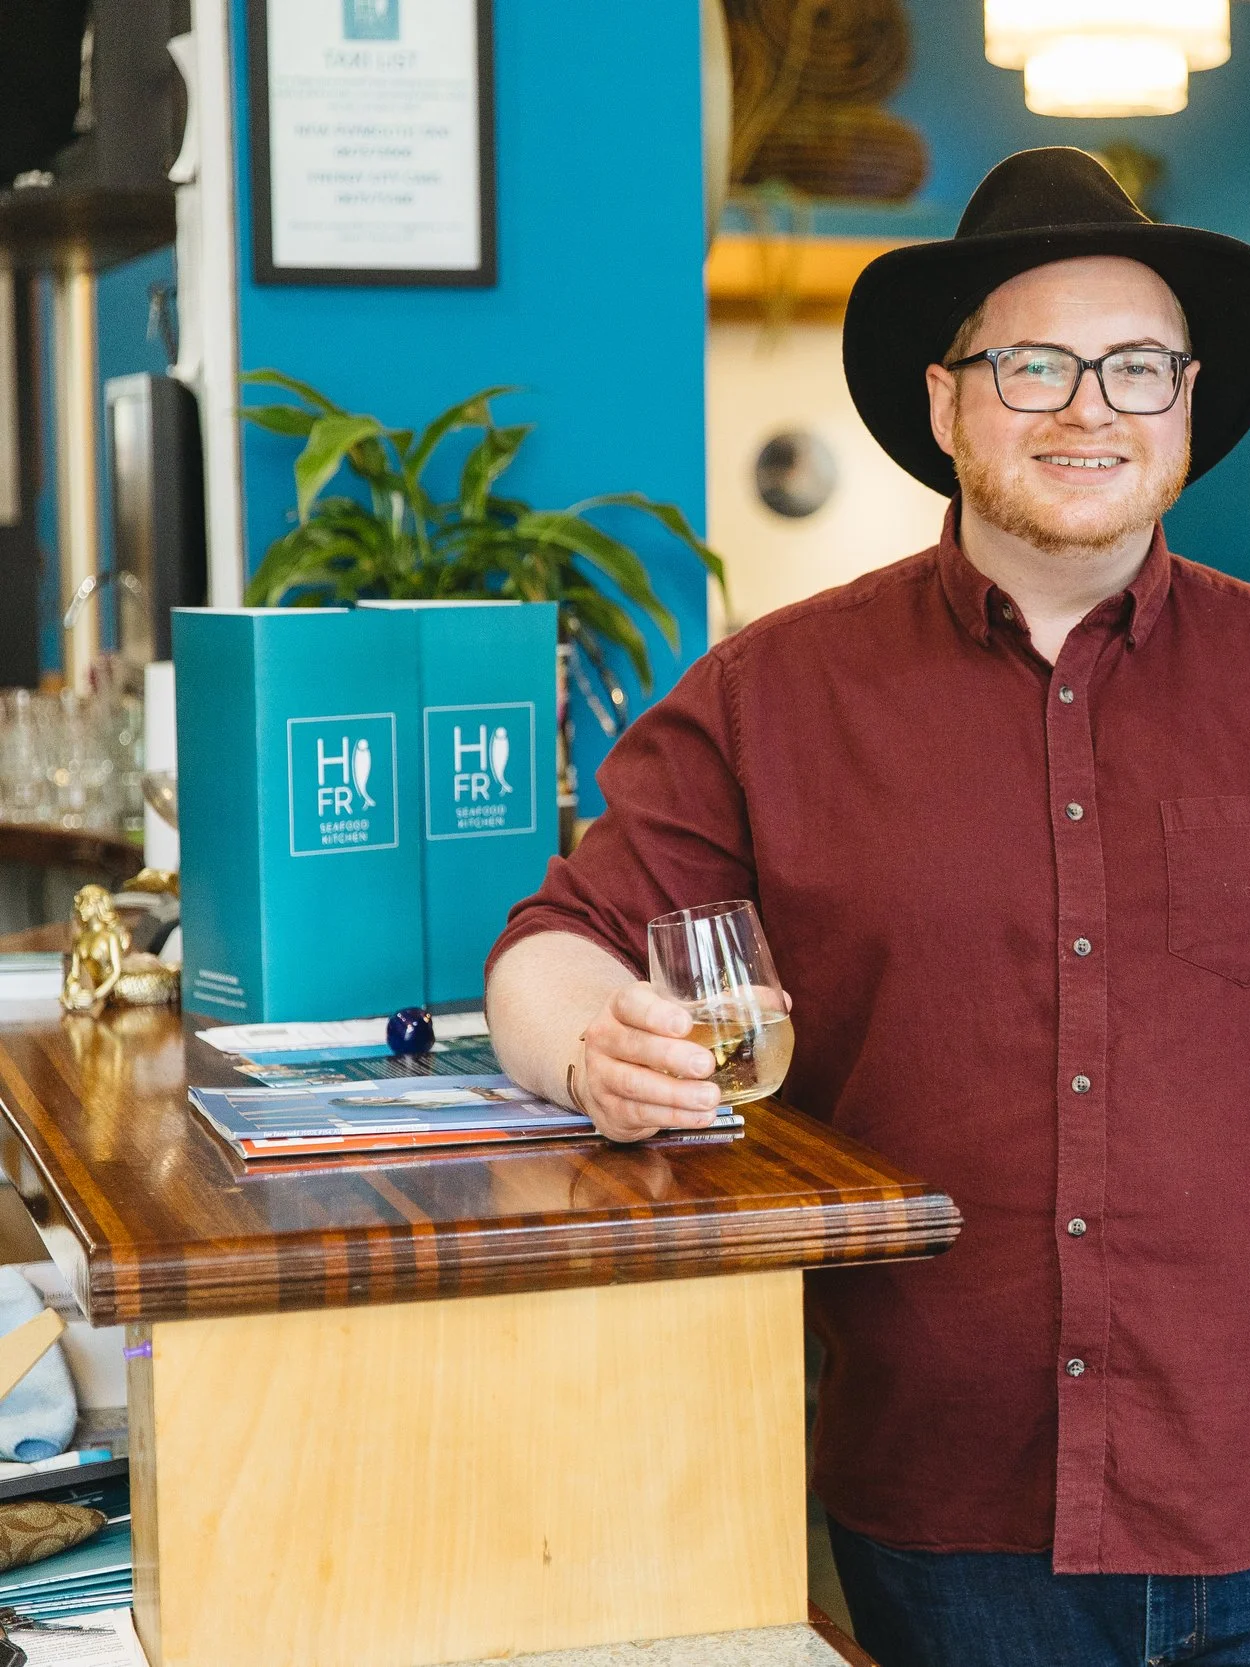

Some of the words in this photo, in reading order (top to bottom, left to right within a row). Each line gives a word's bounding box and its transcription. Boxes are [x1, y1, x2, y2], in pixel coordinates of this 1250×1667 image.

[456, 804, 506, 819] SEAFOOD
[319, 818, 370, 834] SEAFOOD
[457, 816, 505, 830] KITCHEN
[321, 831, 368, 845] KITCHEN
